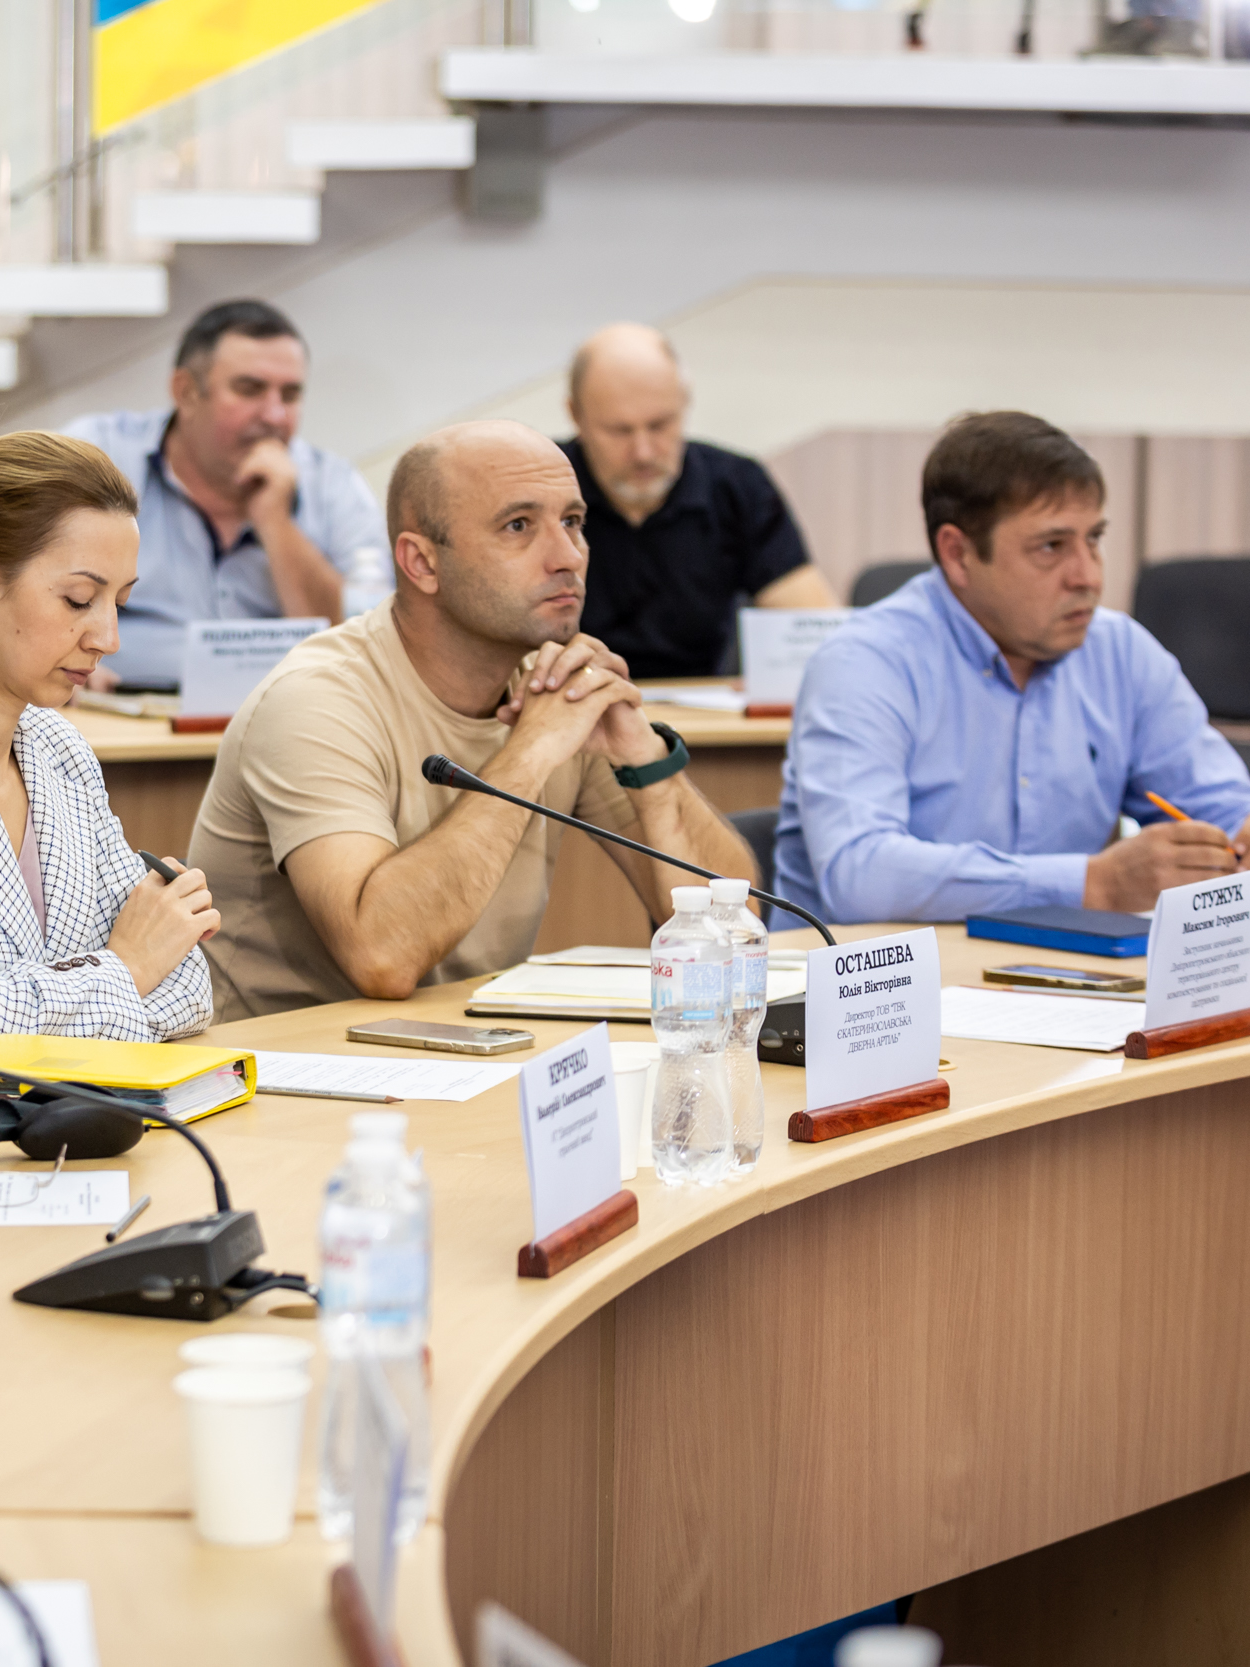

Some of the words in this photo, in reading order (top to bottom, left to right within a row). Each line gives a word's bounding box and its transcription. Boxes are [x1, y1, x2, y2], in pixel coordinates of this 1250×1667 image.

[1192, 884, 1243, 911] СТУЖУК
[1182, 919, 1214, 934] Максим
[1216, 911, 1250, 928] Ігорович
[651, 961, 672, 977] ька
[835, 943, 914, 976] ОСТАШЕВА
[838, 984, 862, 999] Юлія
[864, 975, 912, 995] Вікторівна
[844, 1009, 875, 1024] Директор
[876, 1004, 890, 1016] ТОВ
[836, 1015, 912, 1040] ЄКАТЕРИНОСЛАВСЬКА
[847, 1038, 875, 1054] ДВЕРНА
[548, 1047, 588, 1087] КРЯЧКО
